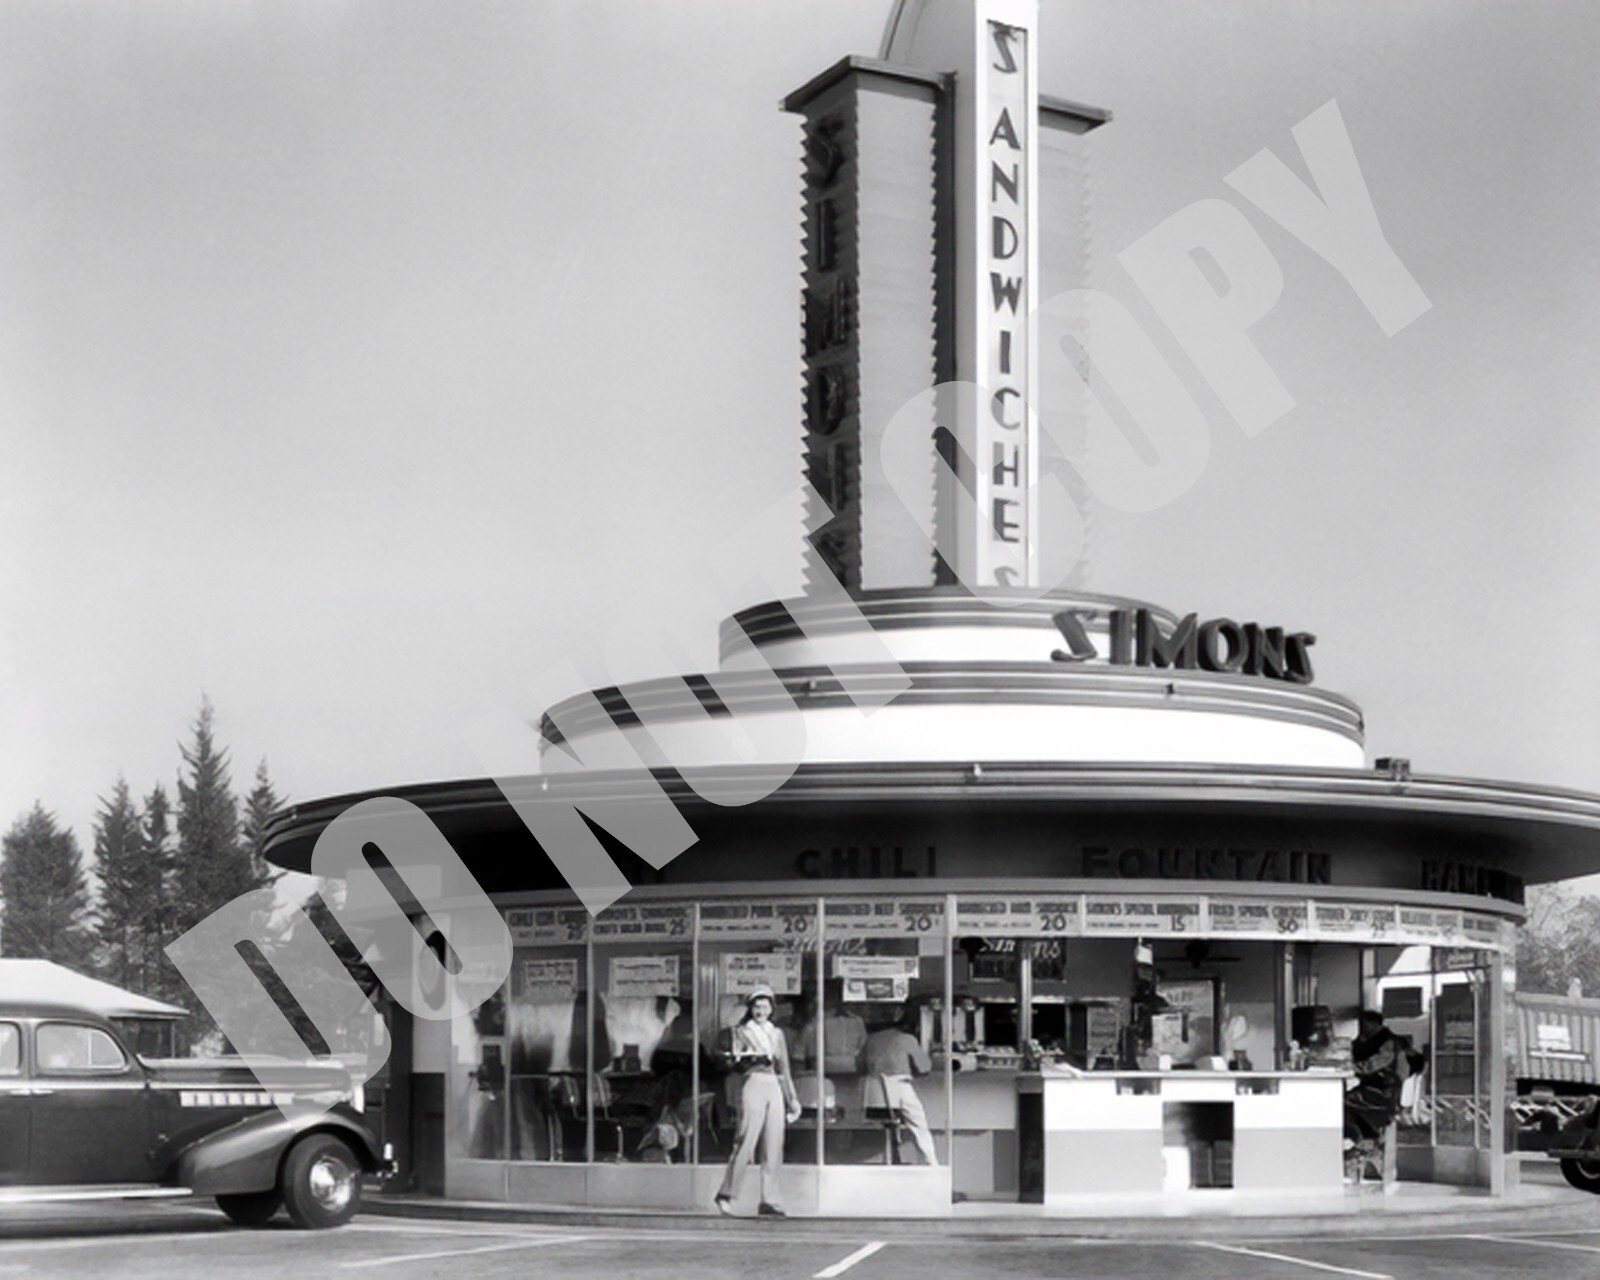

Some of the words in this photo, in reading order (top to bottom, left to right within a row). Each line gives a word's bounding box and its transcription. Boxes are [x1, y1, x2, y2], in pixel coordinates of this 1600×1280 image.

[1051, 607, 1317, 685] SIMONS
[794, 845, 937, 879] CHILI
[1081, 845, 1331, 883] FOUNTAIN
